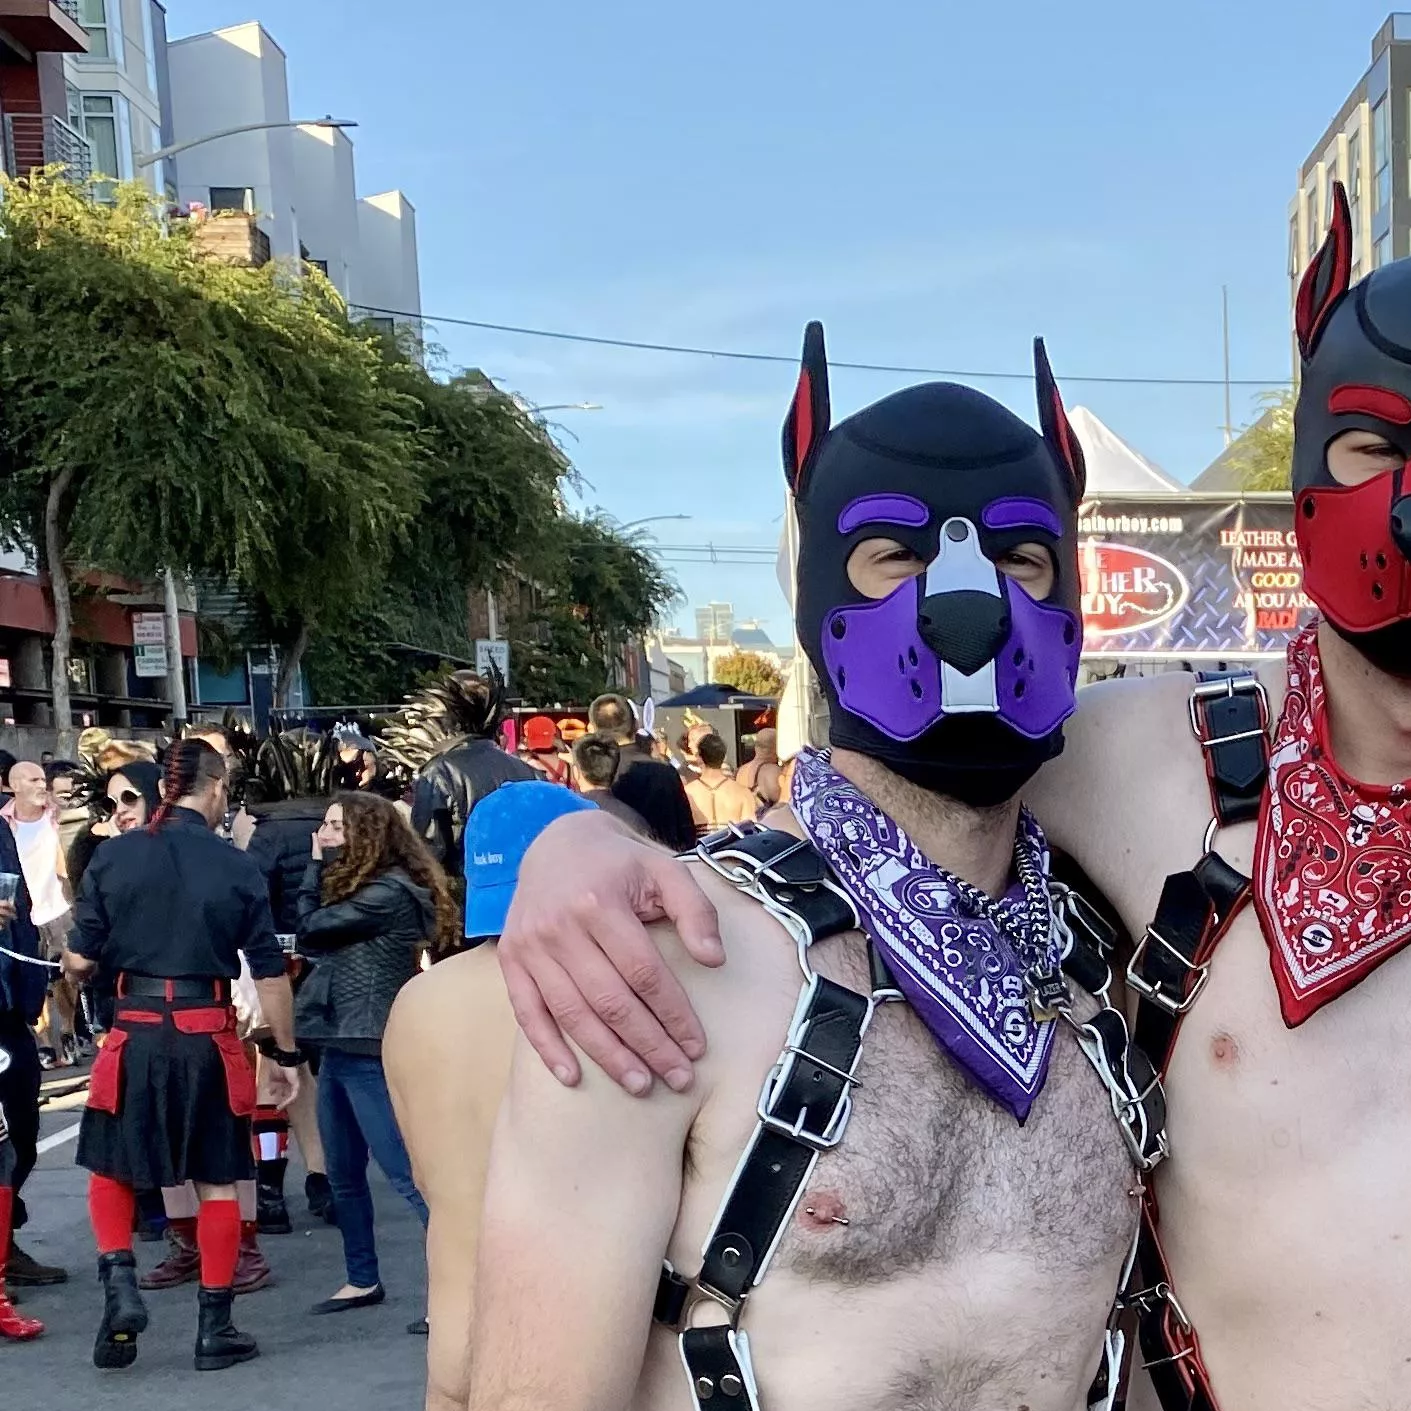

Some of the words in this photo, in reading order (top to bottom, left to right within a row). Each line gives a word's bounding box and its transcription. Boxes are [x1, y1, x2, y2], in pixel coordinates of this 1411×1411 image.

[1221, 530, 1284, 546] LEATHER
[1242, 551, 1287, 567] MADE
[1251, 572, 1299, 588] GOOD
[1253, 592, 1285, 608] YOU
[1256, 607, 1298, 628] BAD!
